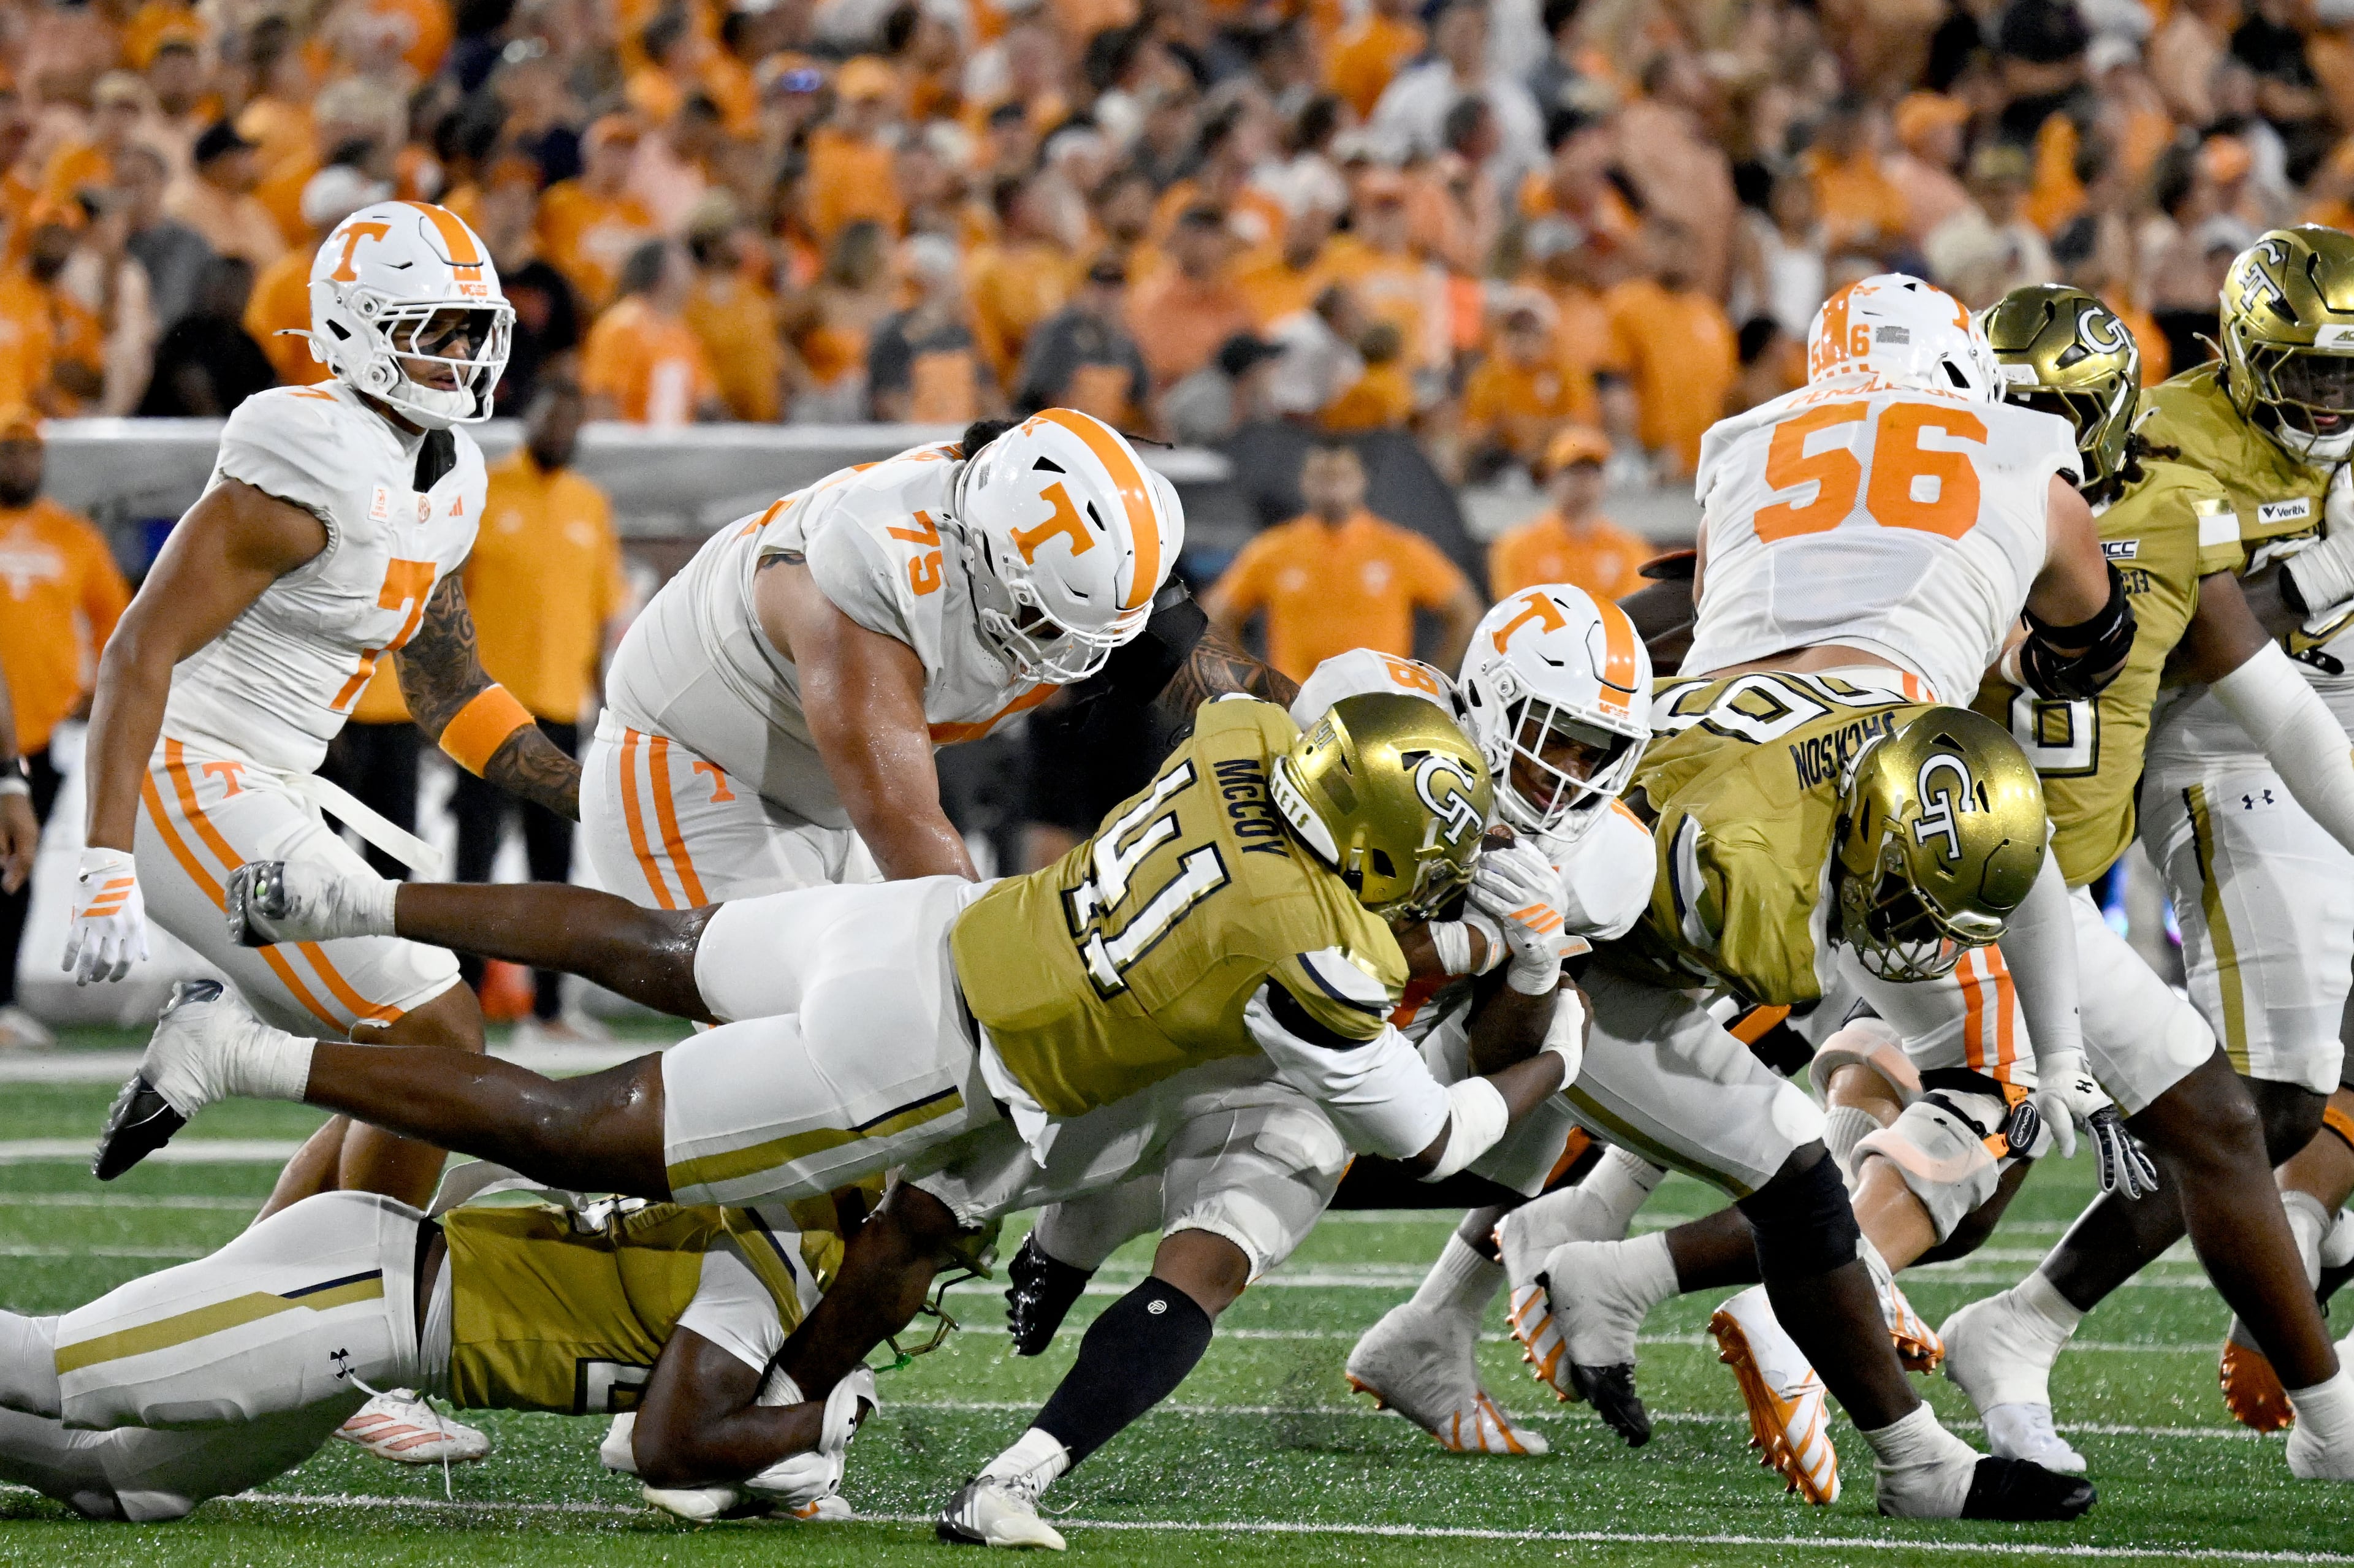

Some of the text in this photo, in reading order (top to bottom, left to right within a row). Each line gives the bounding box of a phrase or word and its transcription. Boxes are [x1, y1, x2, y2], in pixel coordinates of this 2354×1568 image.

[330, 222, 392, 282] T
[1754, 400, 1988, 544] 56
[886, 510, 950, 596] 75
[1010, 481, 1095, 565] T
[330, 557, 436, 710] 7
[1492, 592, 1566, 655] T
[1314, 721, 1336, 752] 41
[202, 761, 246, 799] T
[1415, 755, 1483, 846] GT
[1912, 753, 1976, 861] GT
[1061, 757, 1232, 1001] 41
[2017, 1108, 2032, 1145] DONJOY
